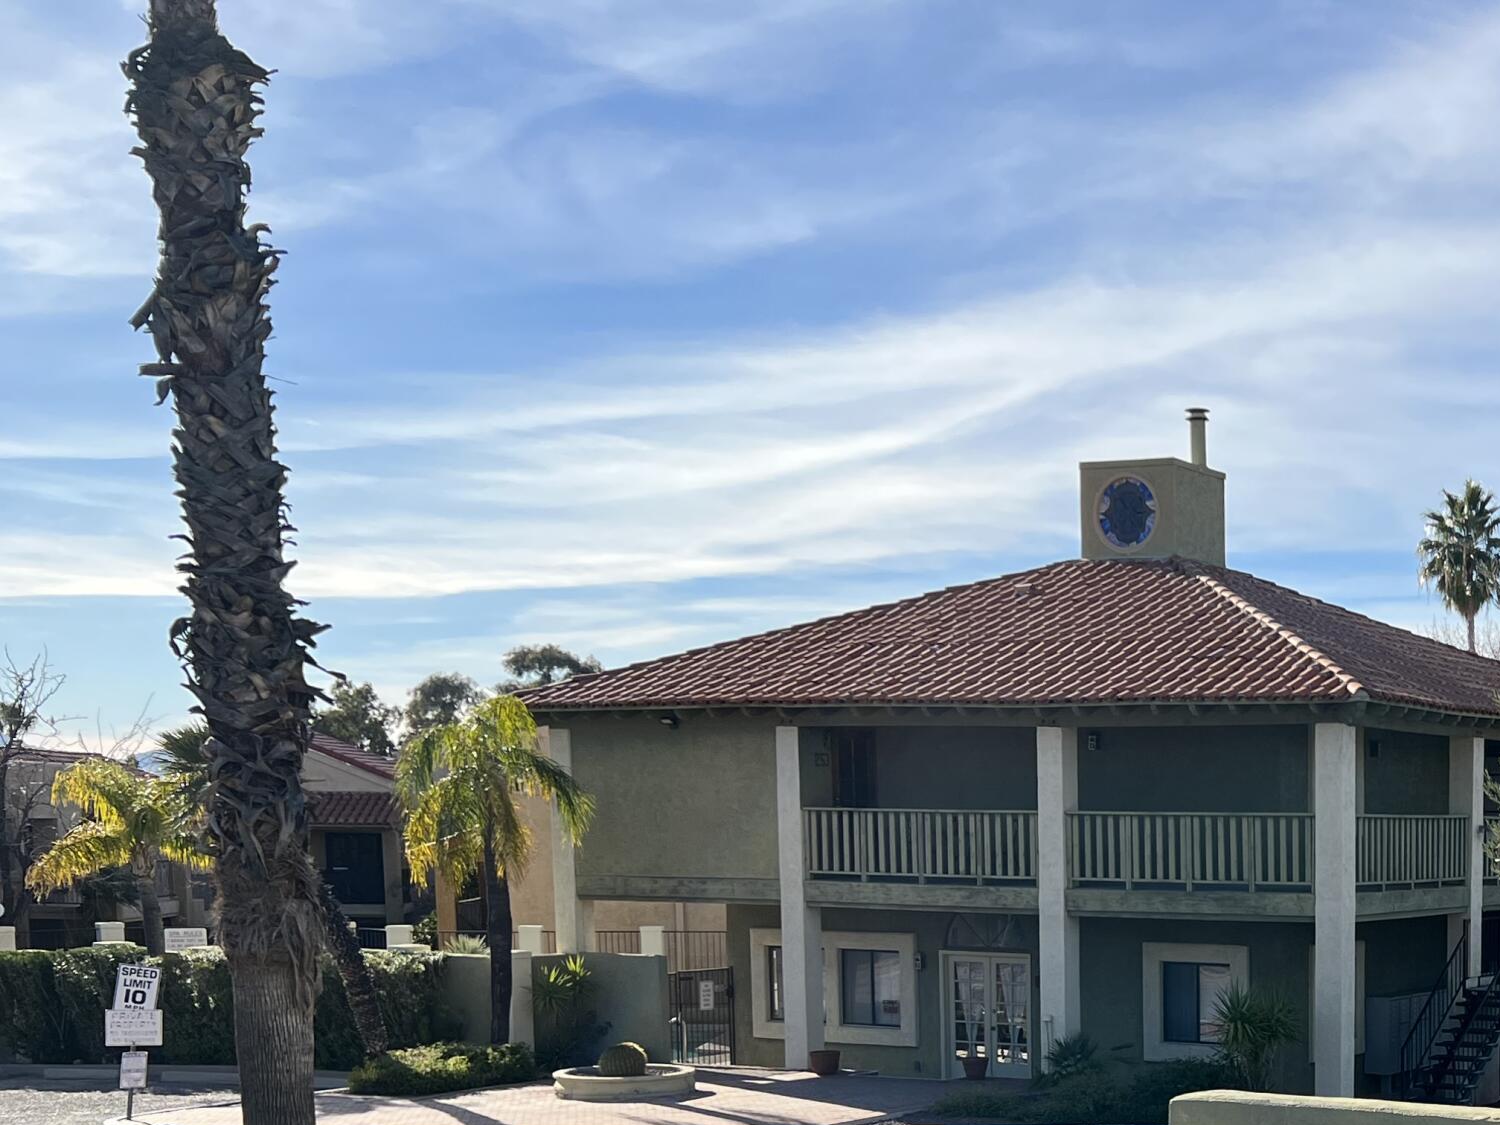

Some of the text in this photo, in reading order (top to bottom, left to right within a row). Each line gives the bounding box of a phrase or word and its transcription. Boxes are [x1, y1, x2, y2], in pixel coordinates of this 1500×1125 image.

[121, 966, 158, 979] SPEED
[123, 978, 153, 989] LIMIT
[124, 989, 147, 1005] 10
